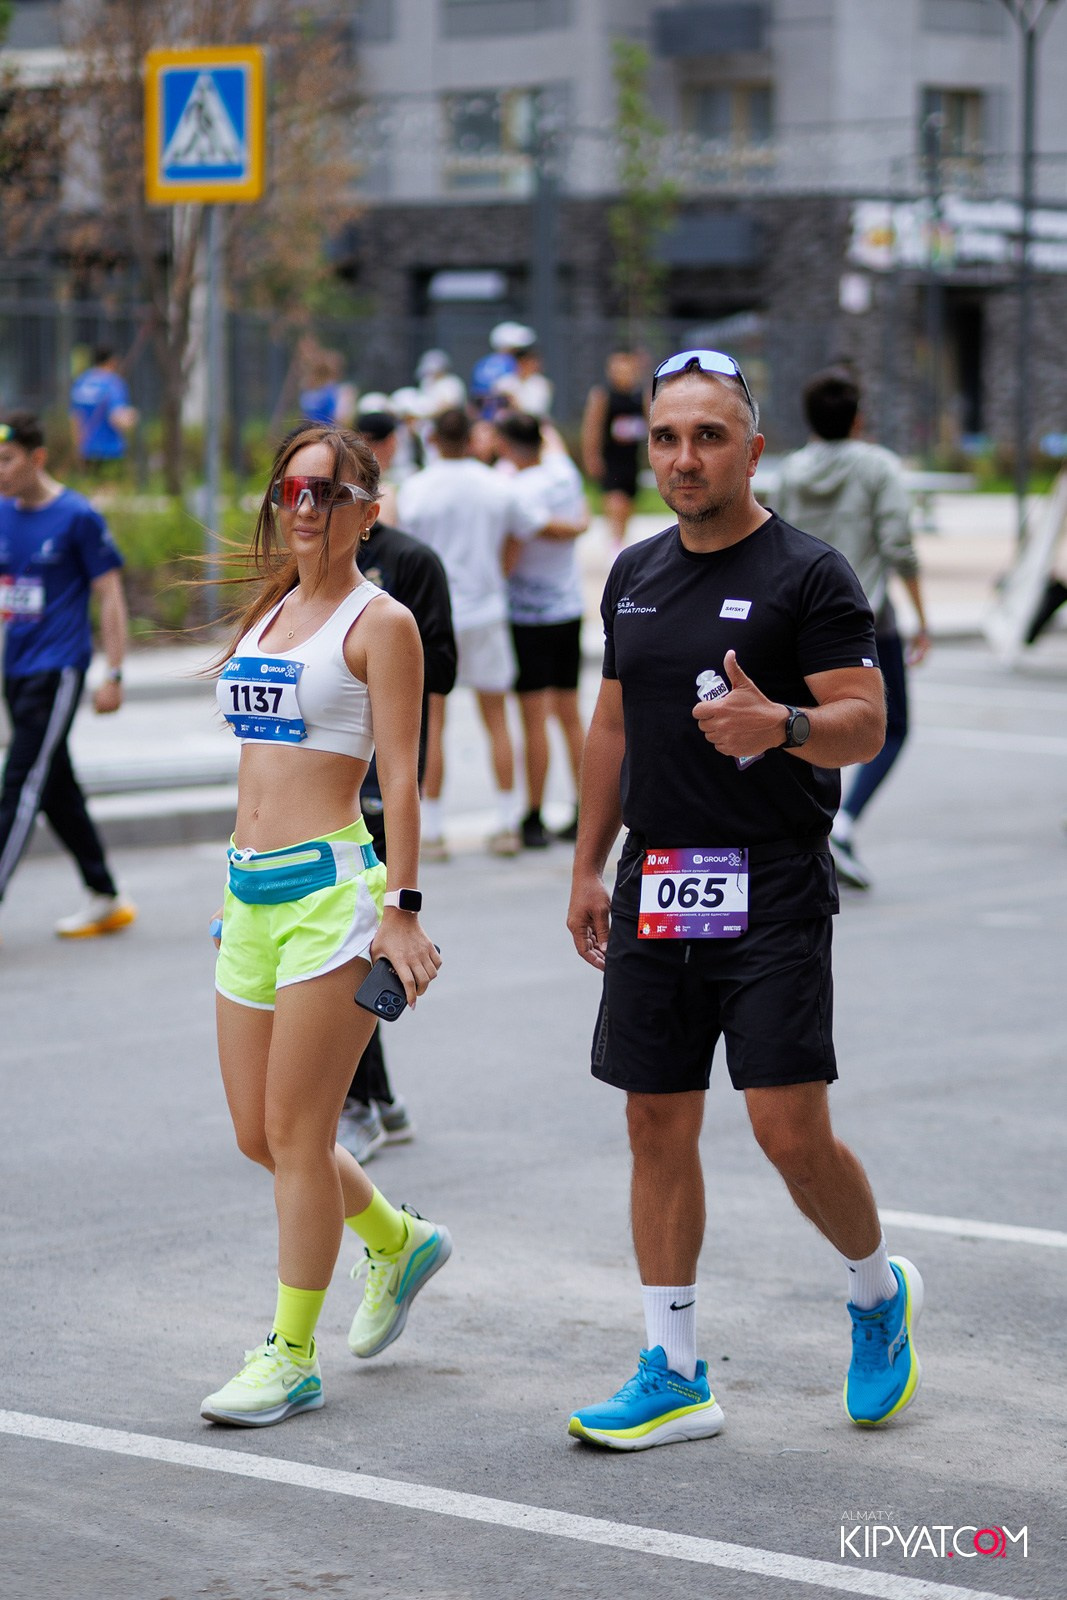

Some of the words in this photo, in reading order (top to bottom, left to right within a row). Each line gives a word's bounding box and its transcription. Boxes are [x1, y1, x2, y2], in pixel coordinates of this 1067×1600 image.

[230, 684, 283, 714] 1137
[647, 855, 656, 866] 10
[658, 878, 728, 909] 065
